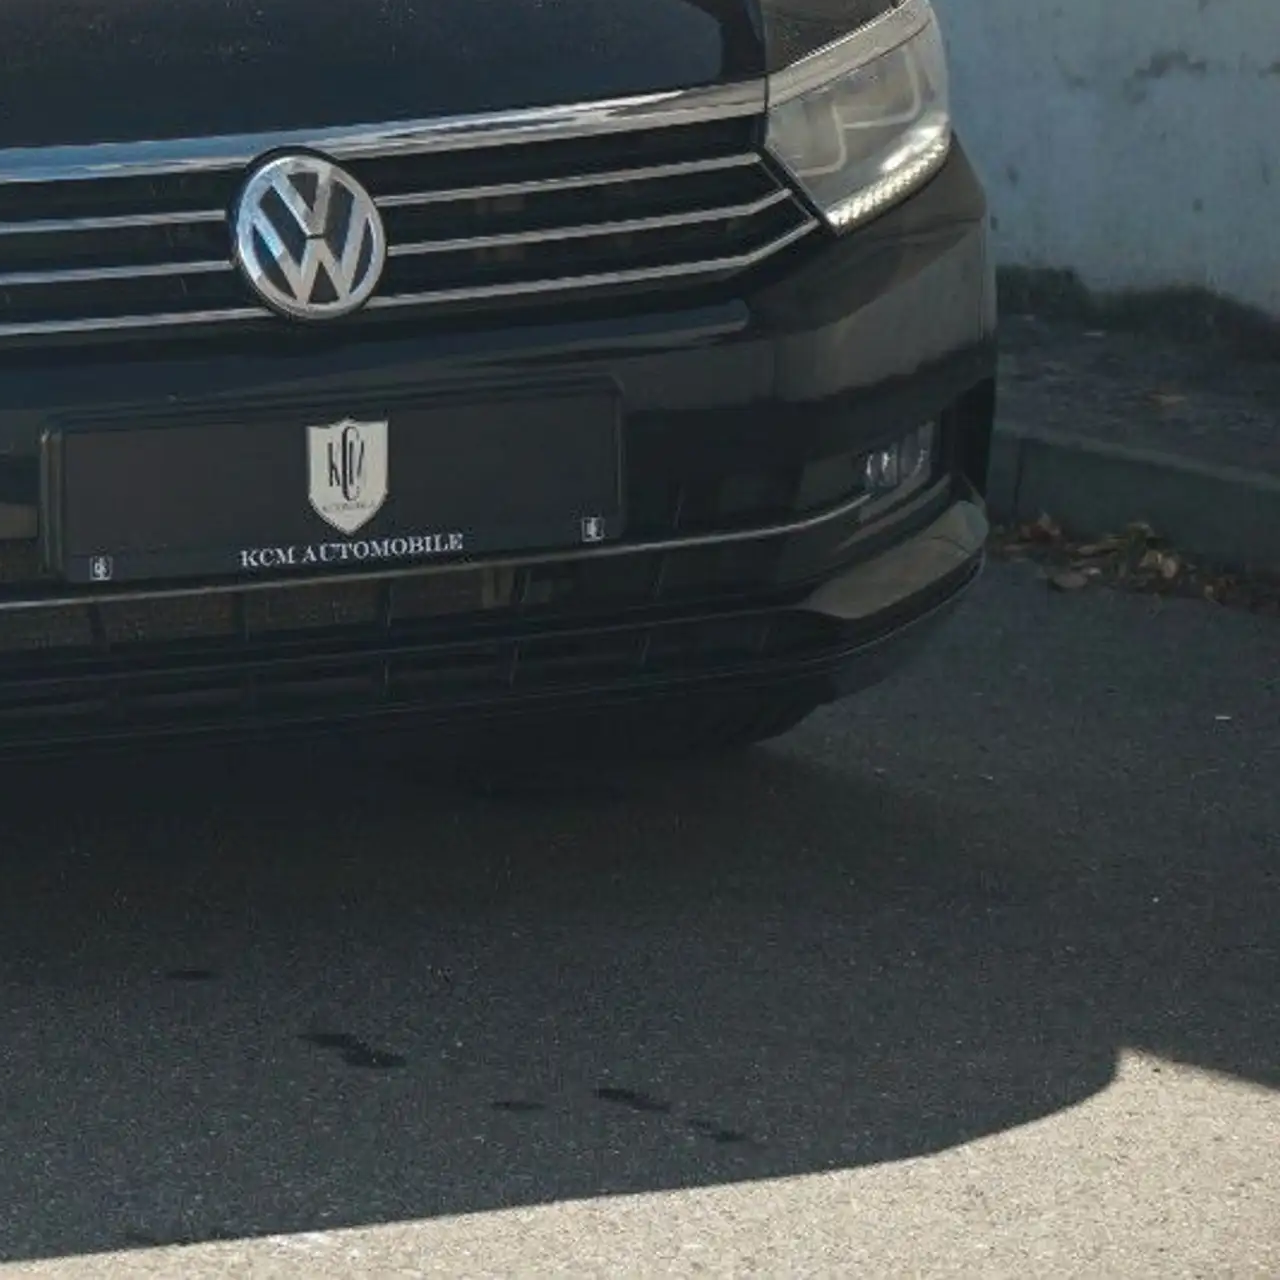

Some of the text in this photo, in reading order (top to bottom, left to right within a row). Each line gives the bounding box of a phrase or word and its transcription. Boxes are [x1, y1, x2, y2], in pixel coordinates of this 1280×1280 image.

[238, 157, 385, 318] VW
[240, 533, 464, 567] KCM AUTOMOBILE
